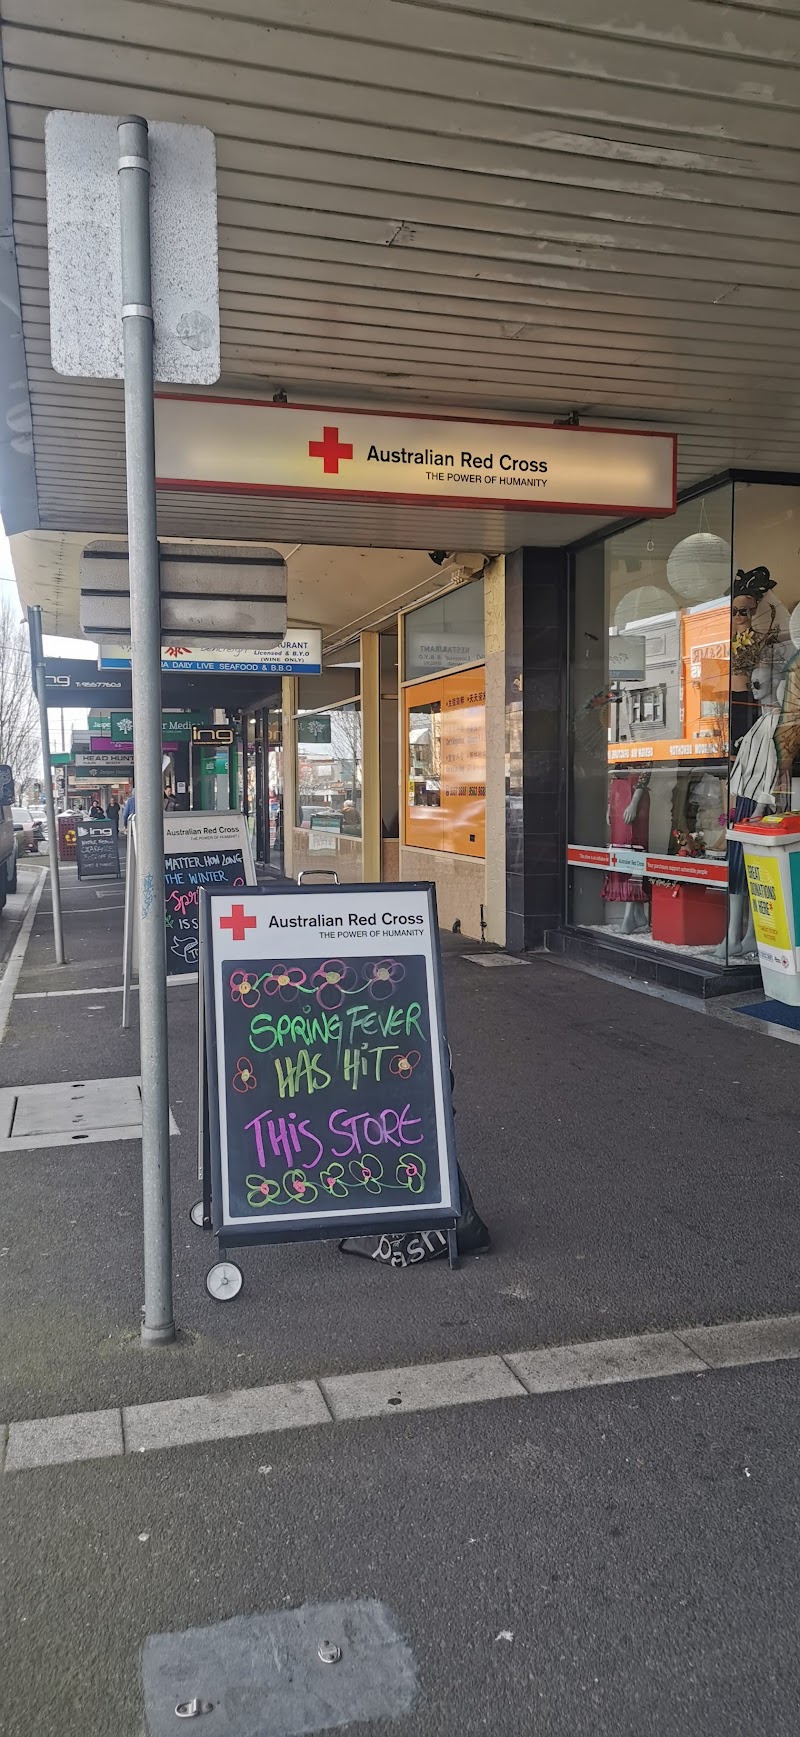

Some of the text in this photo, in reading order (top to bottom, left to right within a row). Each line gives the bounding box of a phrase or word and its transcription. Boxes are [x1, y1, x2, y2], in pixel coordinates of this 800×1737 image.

[367, 445, 548, 473] Australian Red Cross
[426, 471, 548, 487] THE POWER OF HUMANITY
[45, 675, 70, 687] ng
[169, 721, 203, 730] Medi
[193, 726, 233, 745] ing
[90, 828, 113, 837] ing
[165, 853, 244, 871] MATTER HOW LONG
[164, 871, 228, 884] THE WINTER
[750, 882, 776, 900] DONATIONS
[179, 918, 190, 930] IS
[268, 912, 424, 929] Australian Red Cross
[319, 928, 424, 939] THE POWER OF HUMANITY
[346, 1002, 427, 1044] FEVER
[275, 1049, 331, 1098] HAS
[328, 1104, 424, 1157] STORE
